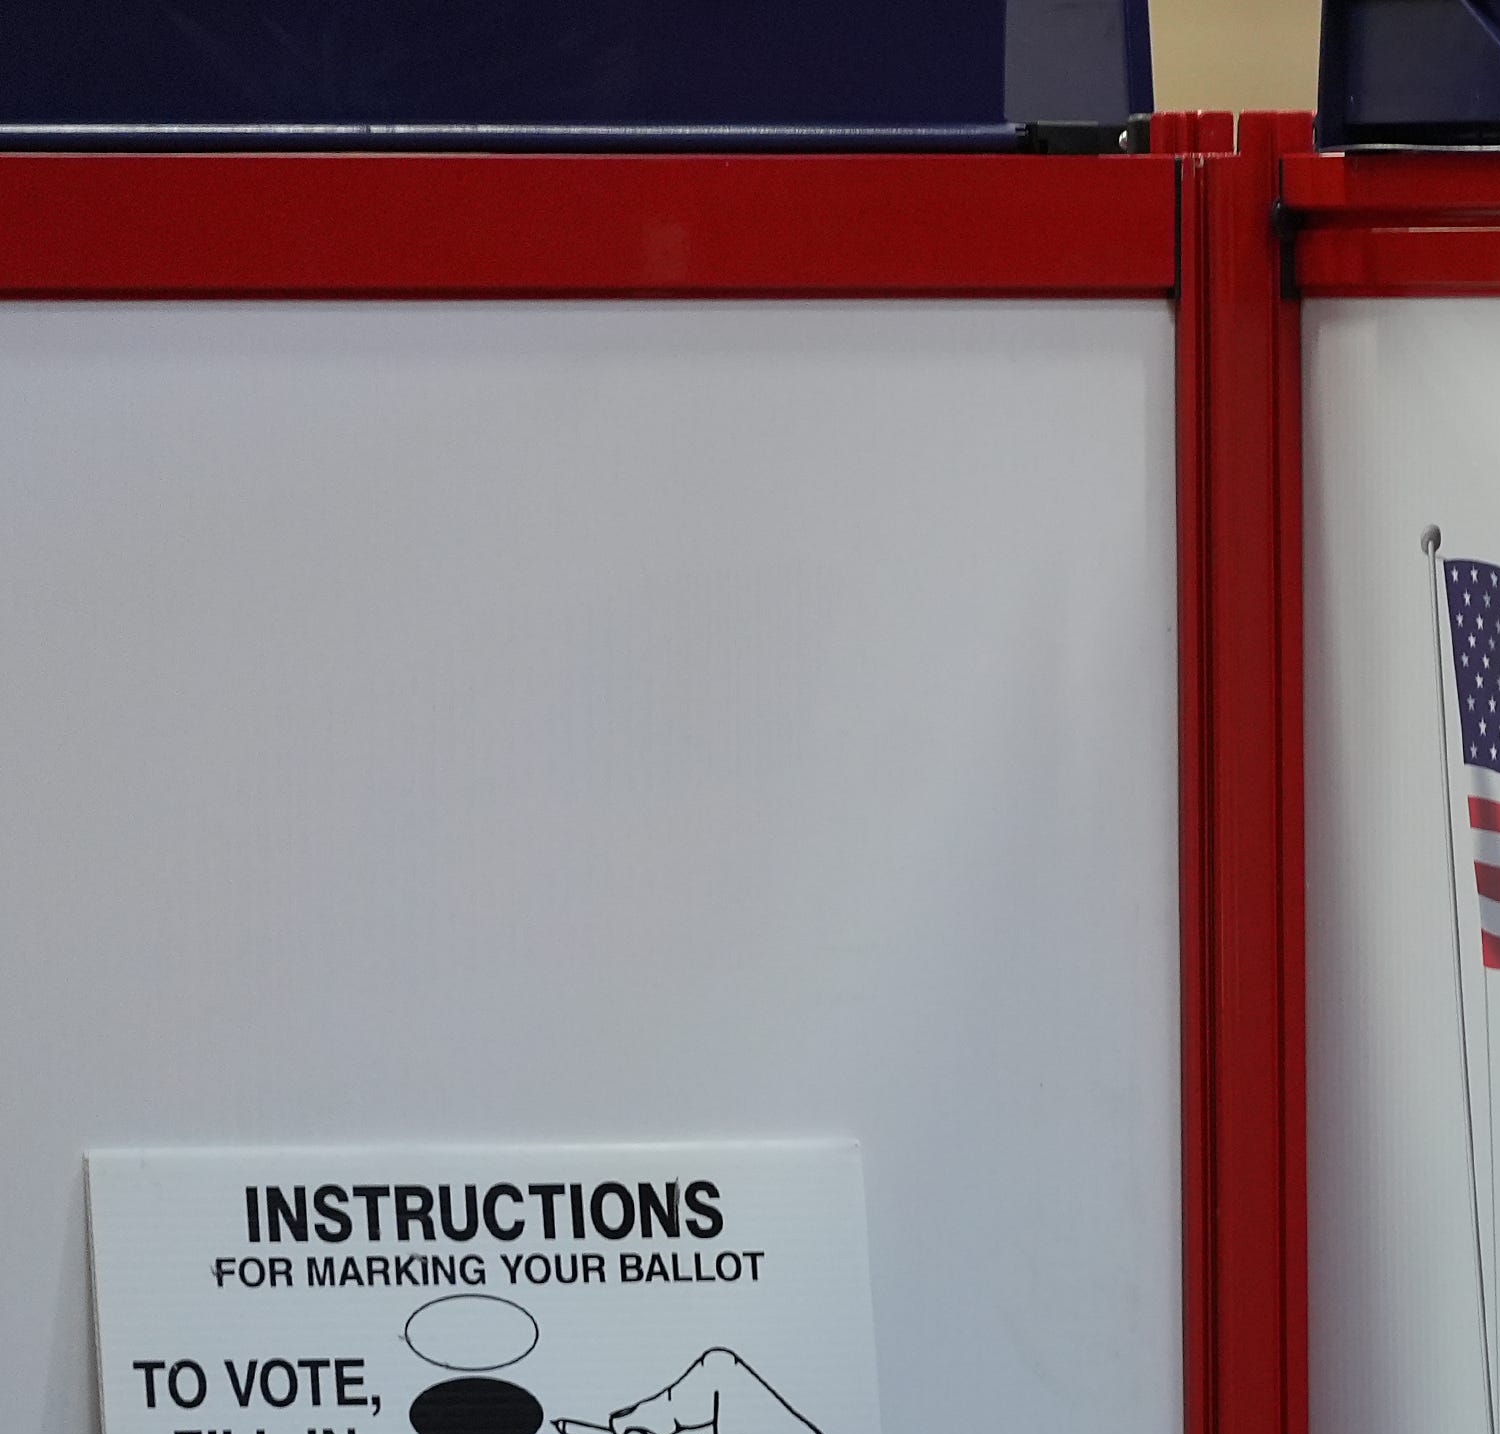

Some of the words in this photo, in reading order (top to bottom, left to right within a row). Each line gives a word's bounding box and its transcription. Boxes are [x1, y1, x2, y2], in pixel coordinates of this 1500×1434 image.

[245, 1180, 724, 1244] INSTRUCTIONS
[211, 1256, 294, 1289] FOR
[306, 1253, 486, 1287] MARKING
[501, 1252, 606, 1285] YOUR
[619, 1251, 765, 1283] BALLOT
[132, 1358, 208, 1410] TO
[223, 1358, 381, 1415] VOTE,
